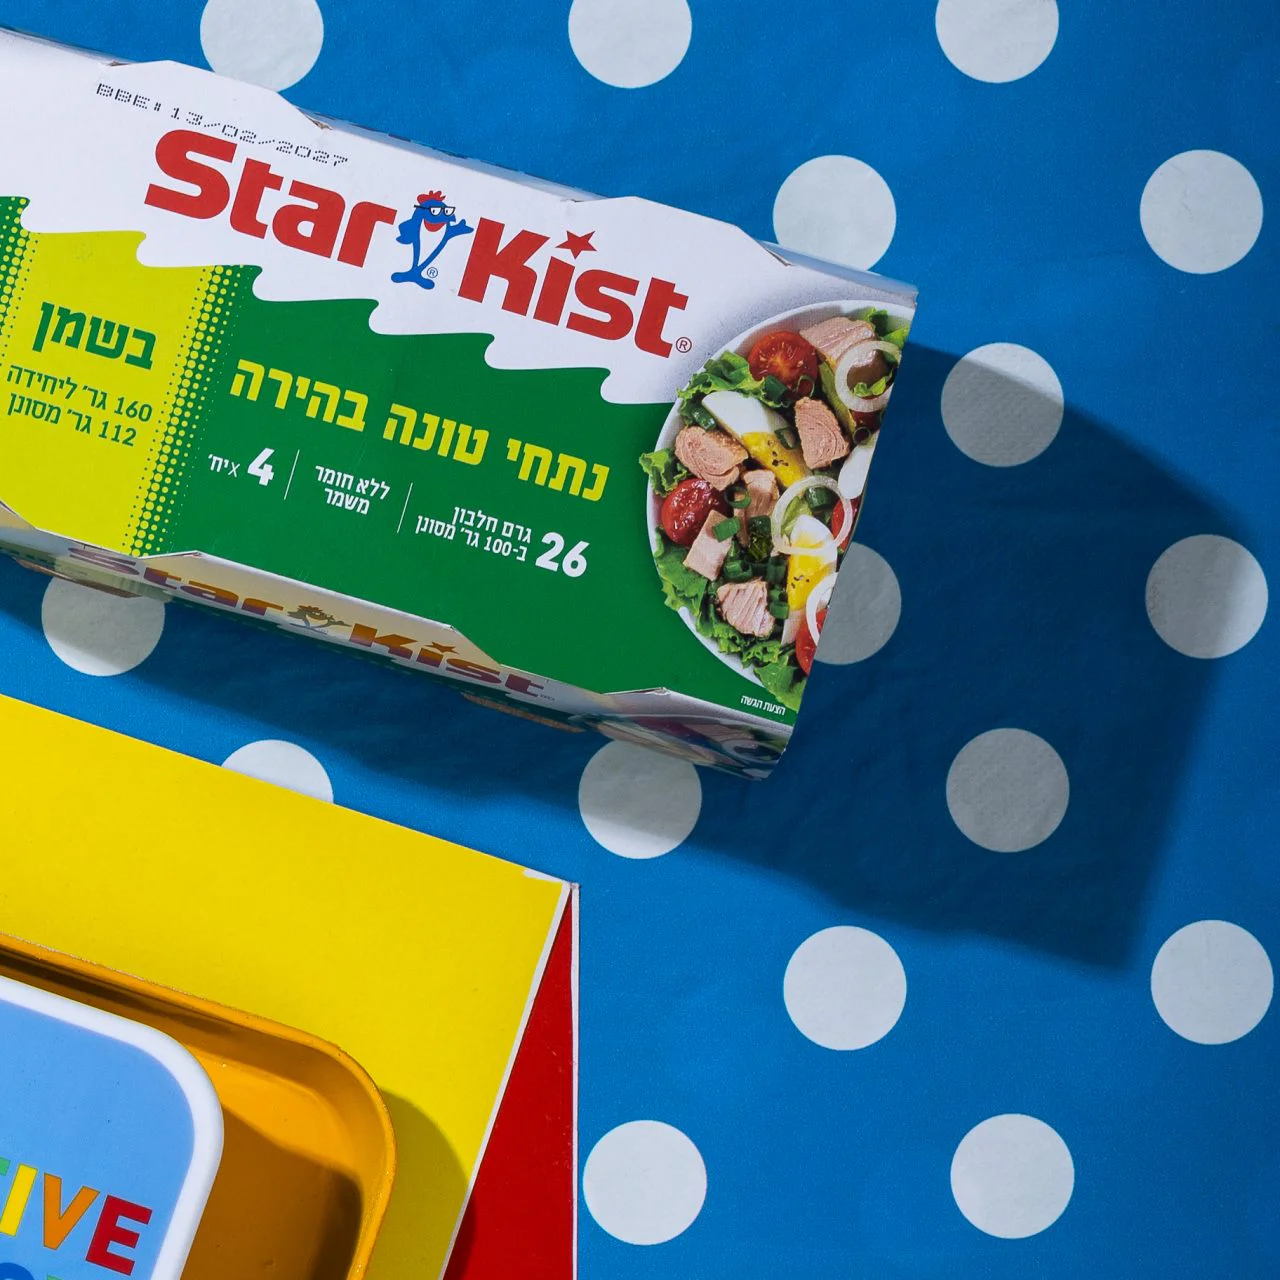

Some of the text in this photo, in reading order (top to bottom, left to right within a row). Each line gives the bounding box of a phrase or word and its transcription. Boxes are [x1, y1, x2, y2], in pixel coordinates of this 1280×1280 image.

[169, 106, 349, 168] 13/02/2027
[144, 128, 690, 359] Star Kist
[32, 301, 157, 371] בשמן
[6, 364, 78, 400] ליחידה
[7, 392, 63, 425] מסונן
[114, 396, 153, 422] 160
[98, 420, 138, 447] 112
[229, 358, 611, 502] נתחי טונה בהירה
[247, 447, 275, 487] 4
[315, 465, 391, 500] ללא חומר
[324, 487, 370, 515] משמר
[415, 515, 457, 541] מסונן
[451, 506, 532, 544] גרם חלבון
[535, 531, 590, 578] 26
[67, 547, 545, 698] Star Kist
[740, 695, 786, 716] הצעת הגשה
